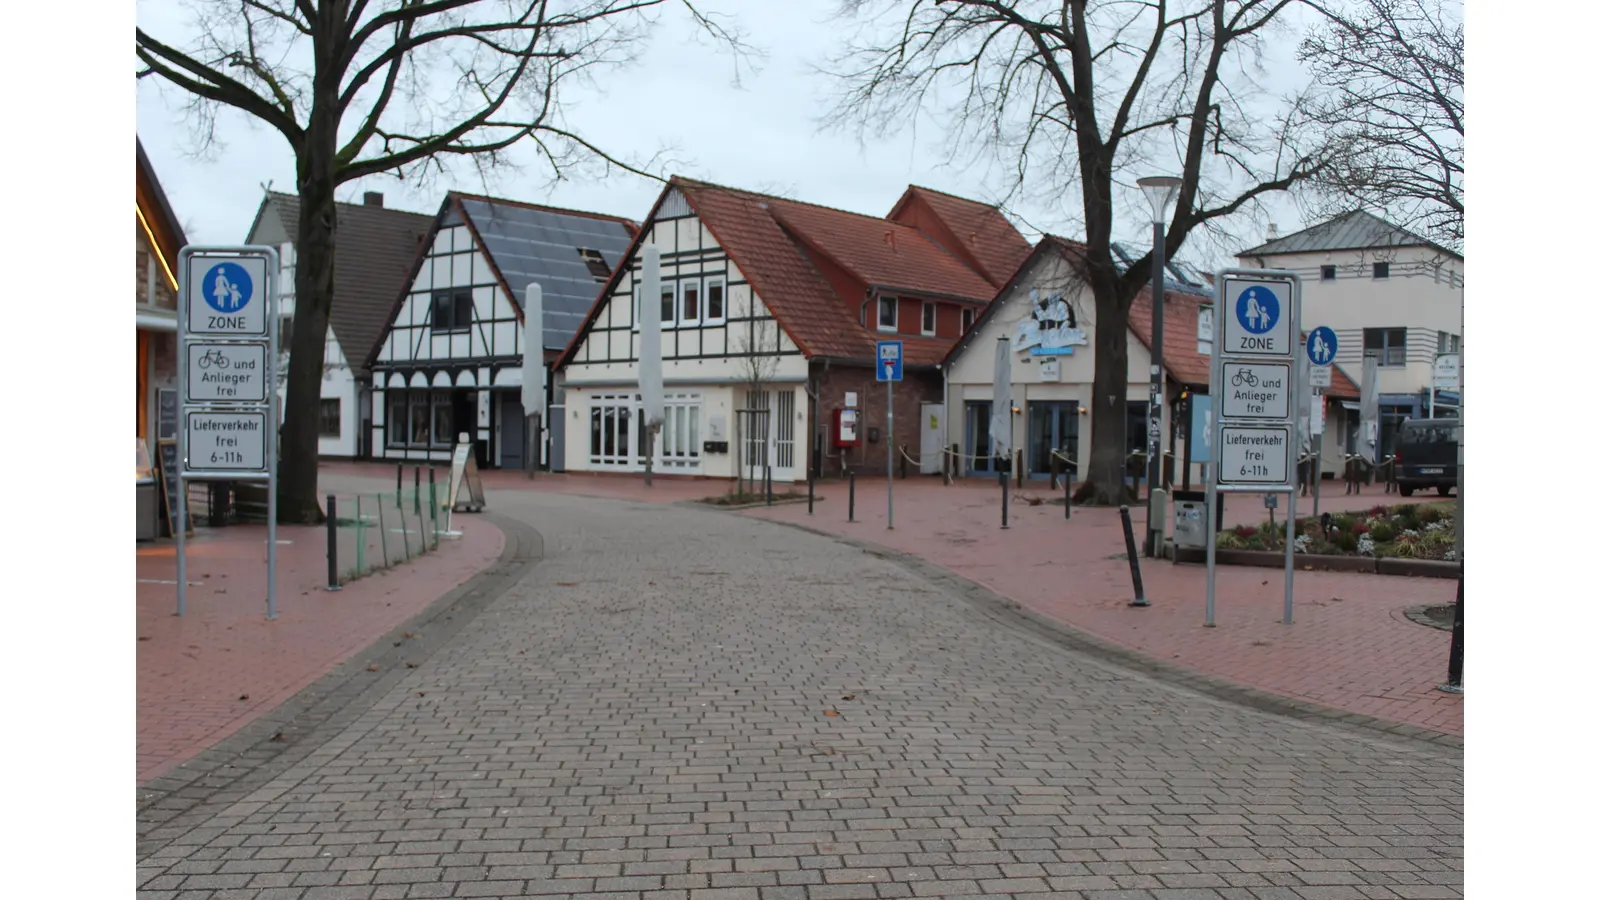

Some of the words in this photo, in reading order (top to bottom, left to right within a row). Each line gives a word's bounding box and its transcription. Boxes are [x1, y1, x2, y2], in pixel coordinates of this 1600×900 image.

[208, 316, 246, 329] ZONE
[1240, 337, 1274, 350] ZONE
[234, 359, 255, 369] und
[202, 372, 251, 385] Anlieger
[1262, 379, 1281, 388] und
[217, 386, 237, 396] frei
[1234, 390, 1277, 402] Anlieger
[1246, 403, 1264, 413] frei
[194, 419, 258, 431] Lieferverkehr
[216, 436, 238, 446] frei
[1226, 434, 1283, 446] Lieferverkehr
[210, 451, 242, 463] 6-11h
[1245, 450, 1264, 461] frei
[1240, 466, 1268, 476] 6-11h
